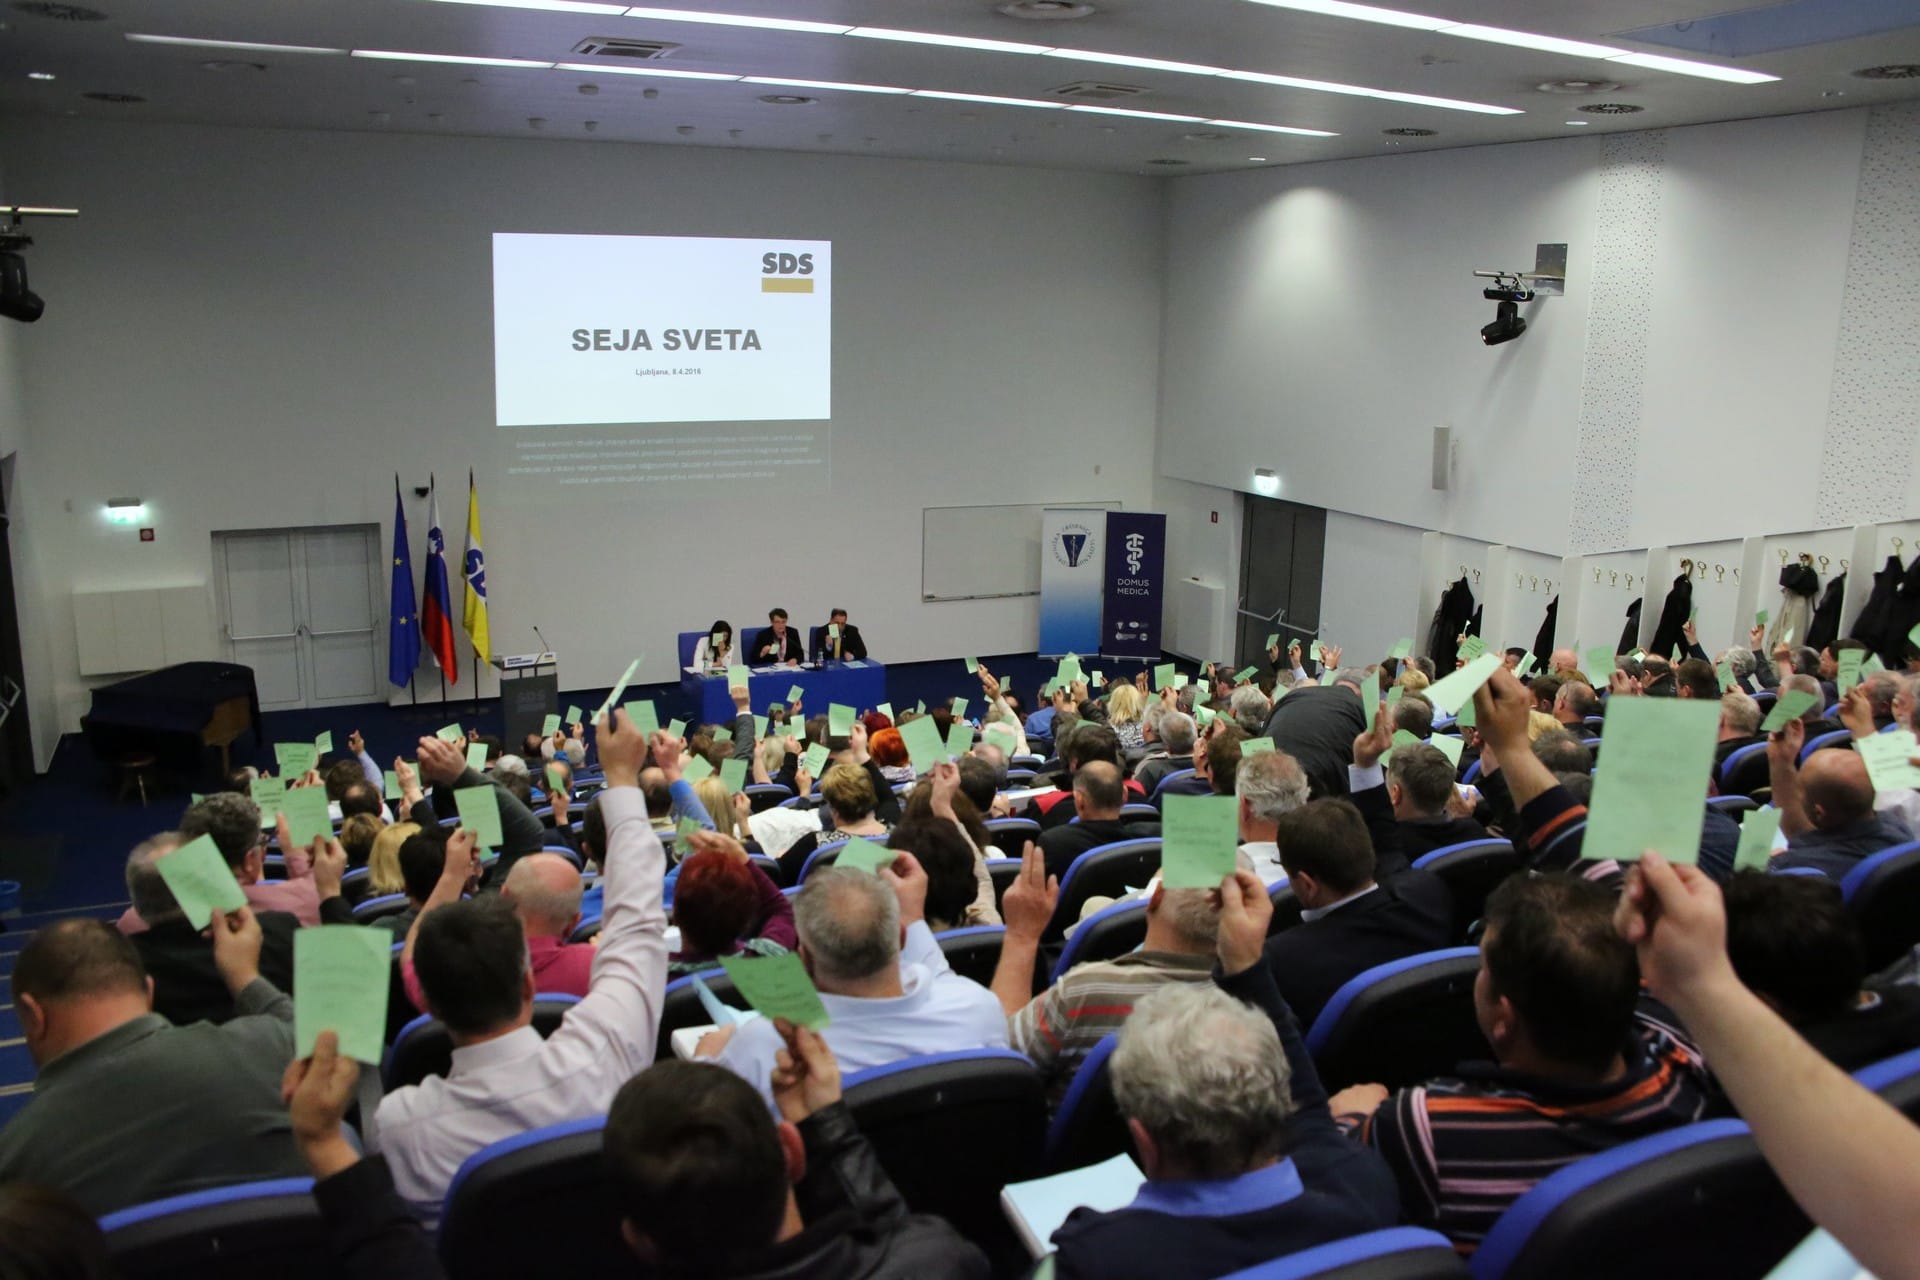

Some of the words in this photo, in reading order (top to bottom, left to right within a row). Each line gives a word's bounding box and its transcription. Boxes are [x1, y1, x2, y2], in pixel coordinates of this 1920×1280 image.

[762, 253, 814, 275] SDS
[572, 329, 653, 351] SEJA
[663, 329, 762, 350] SVETA
[635, 368, 671, 376] Ljubljana,
[1117, 578, 1150, 587] DOMUS
[1116, 587, 1150, 596] MEDICA
